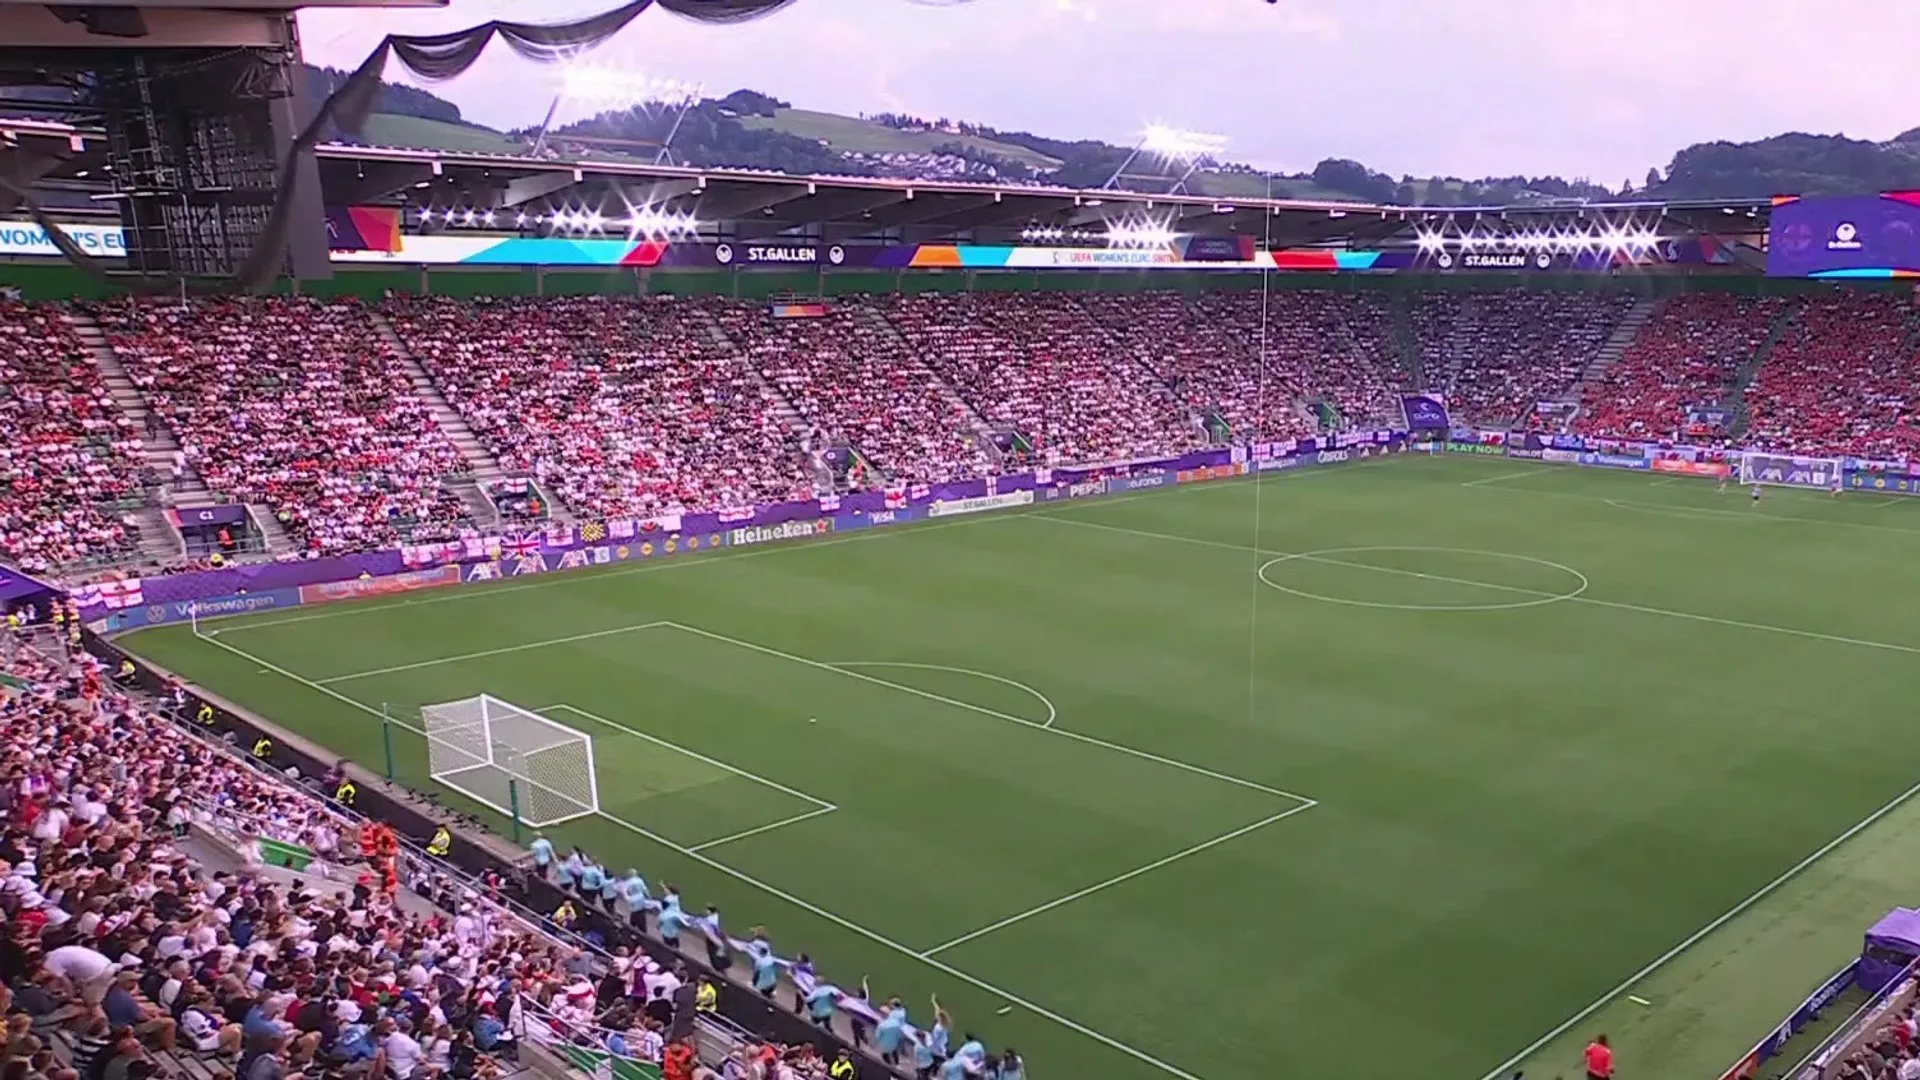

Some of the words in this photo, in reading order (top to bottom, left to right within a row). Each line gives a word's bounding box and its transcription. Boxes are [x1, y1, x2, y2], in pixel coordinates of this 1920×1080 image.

[748, 247, 816, 261] ST.GALLEN
[1070, 252, 1092, 262] UEFA
[1093, 252, 1129, 262] WOMEN'S
[1465, 256, 1525, 267] ST.GALLEN
[1446, 442, 1476, 452] PLAY
[1476, 444, 1504, 455] NOW
[1069, 480, 1106, 499] PEPSI
[870, 510, 895, 525] VISA
[733, 521, 812, 546] Heineken
